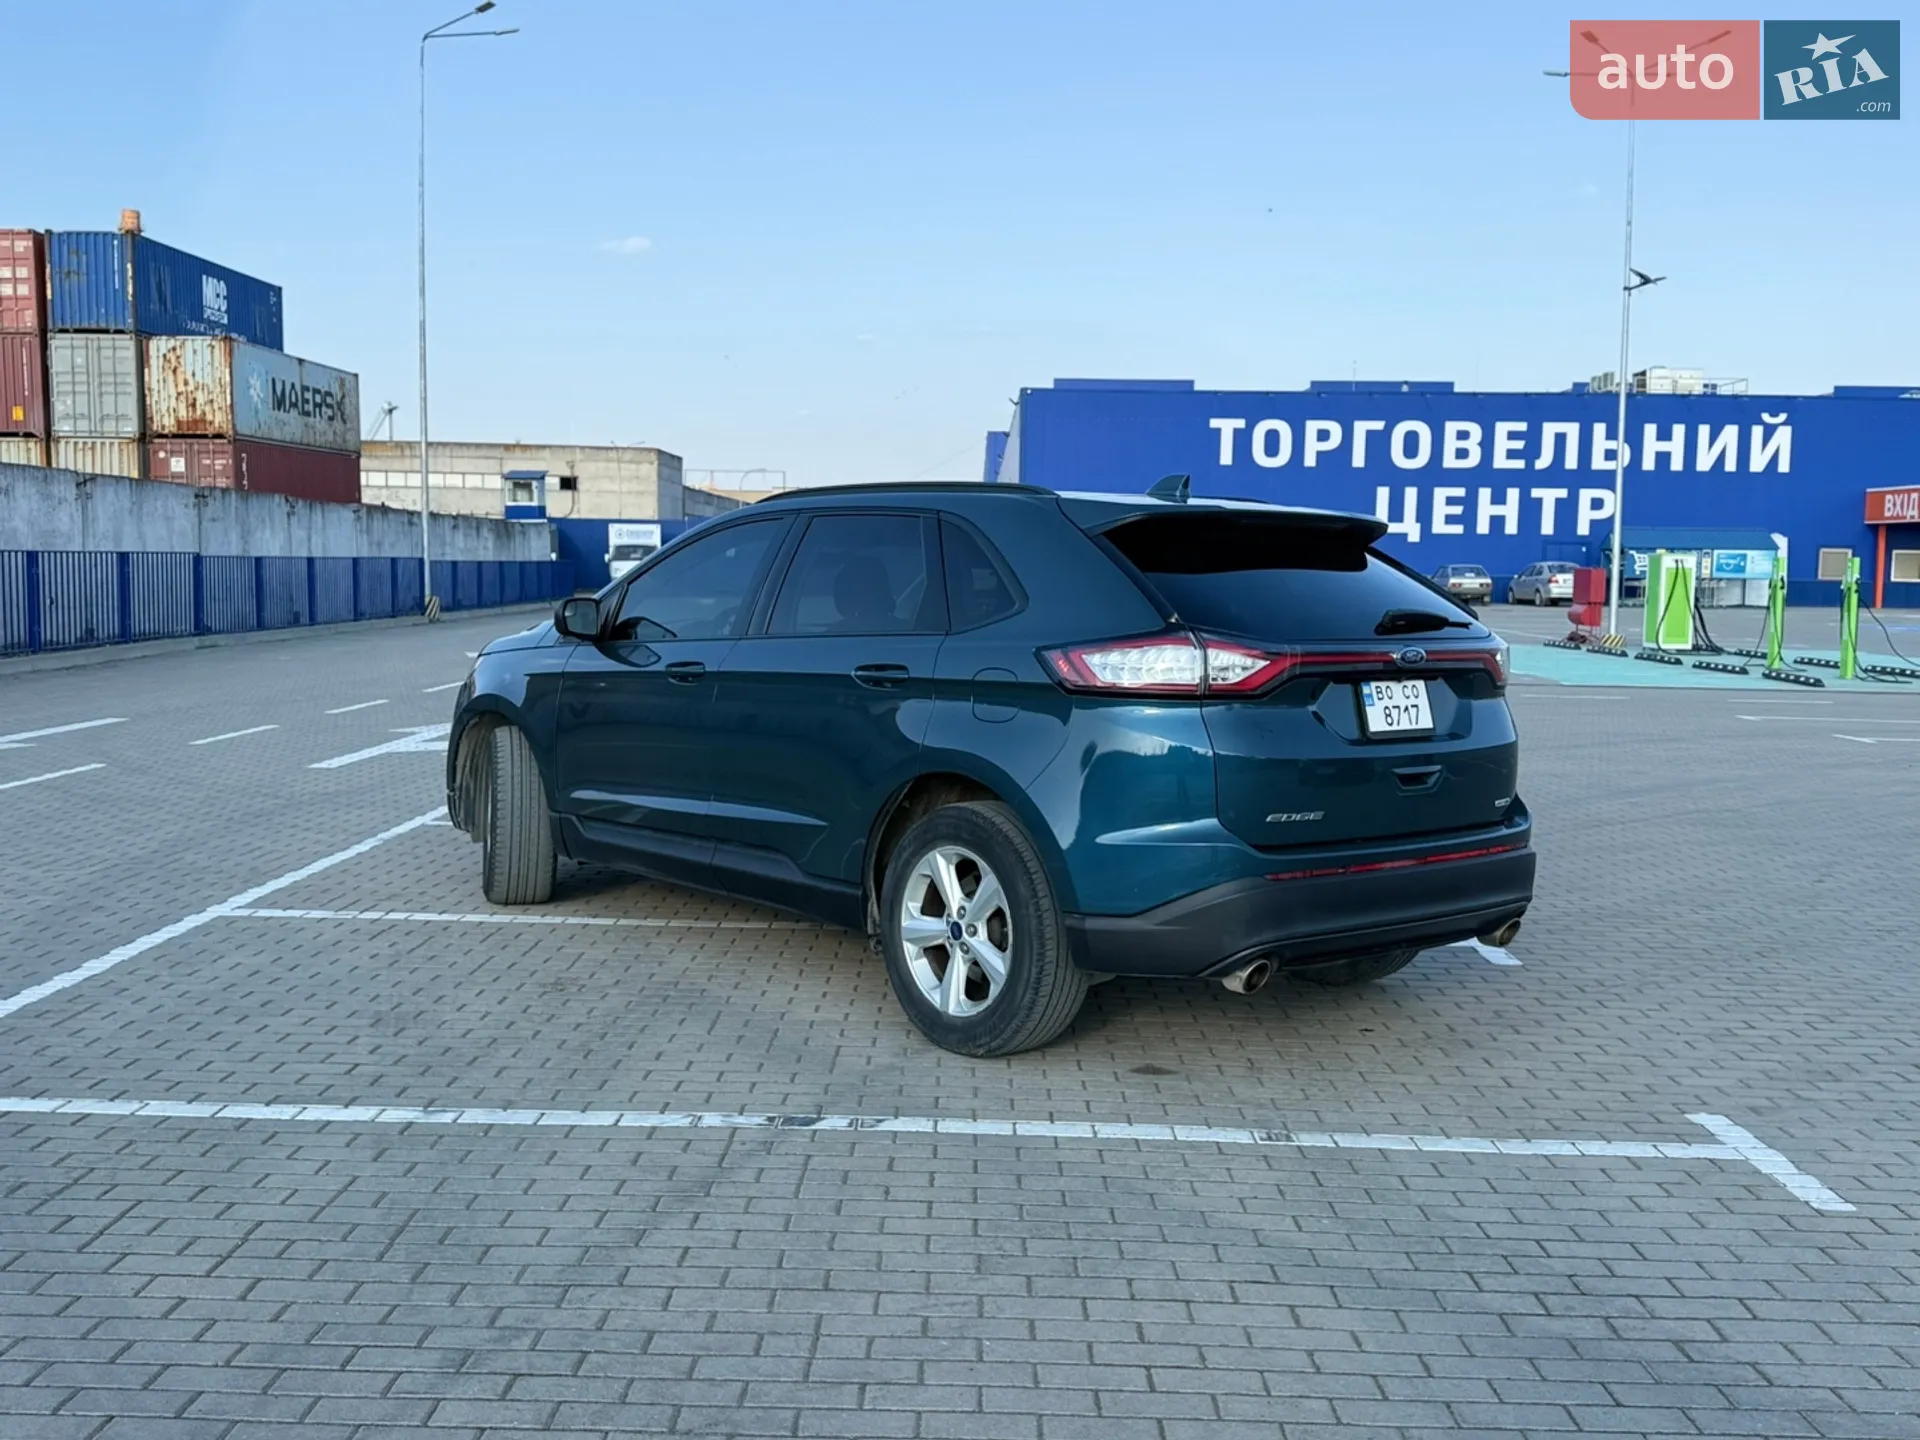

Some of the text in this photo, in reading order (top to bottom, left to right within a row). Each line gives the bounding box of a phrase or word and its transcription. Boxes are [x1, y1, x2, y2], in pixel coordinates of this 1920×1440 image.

[271, 376, 347, 425] MAERSK
[1209, 413, 1793, 474] ТОРГОВЕЛЬНИЙ
[1375, 486, 1616, 543] ЦЕНТР
[1884, 493, 1919, 520] ВХІД
[1383, 704, 1420, 727] 8717
[1265, 810, 1325, 823] EDGE
